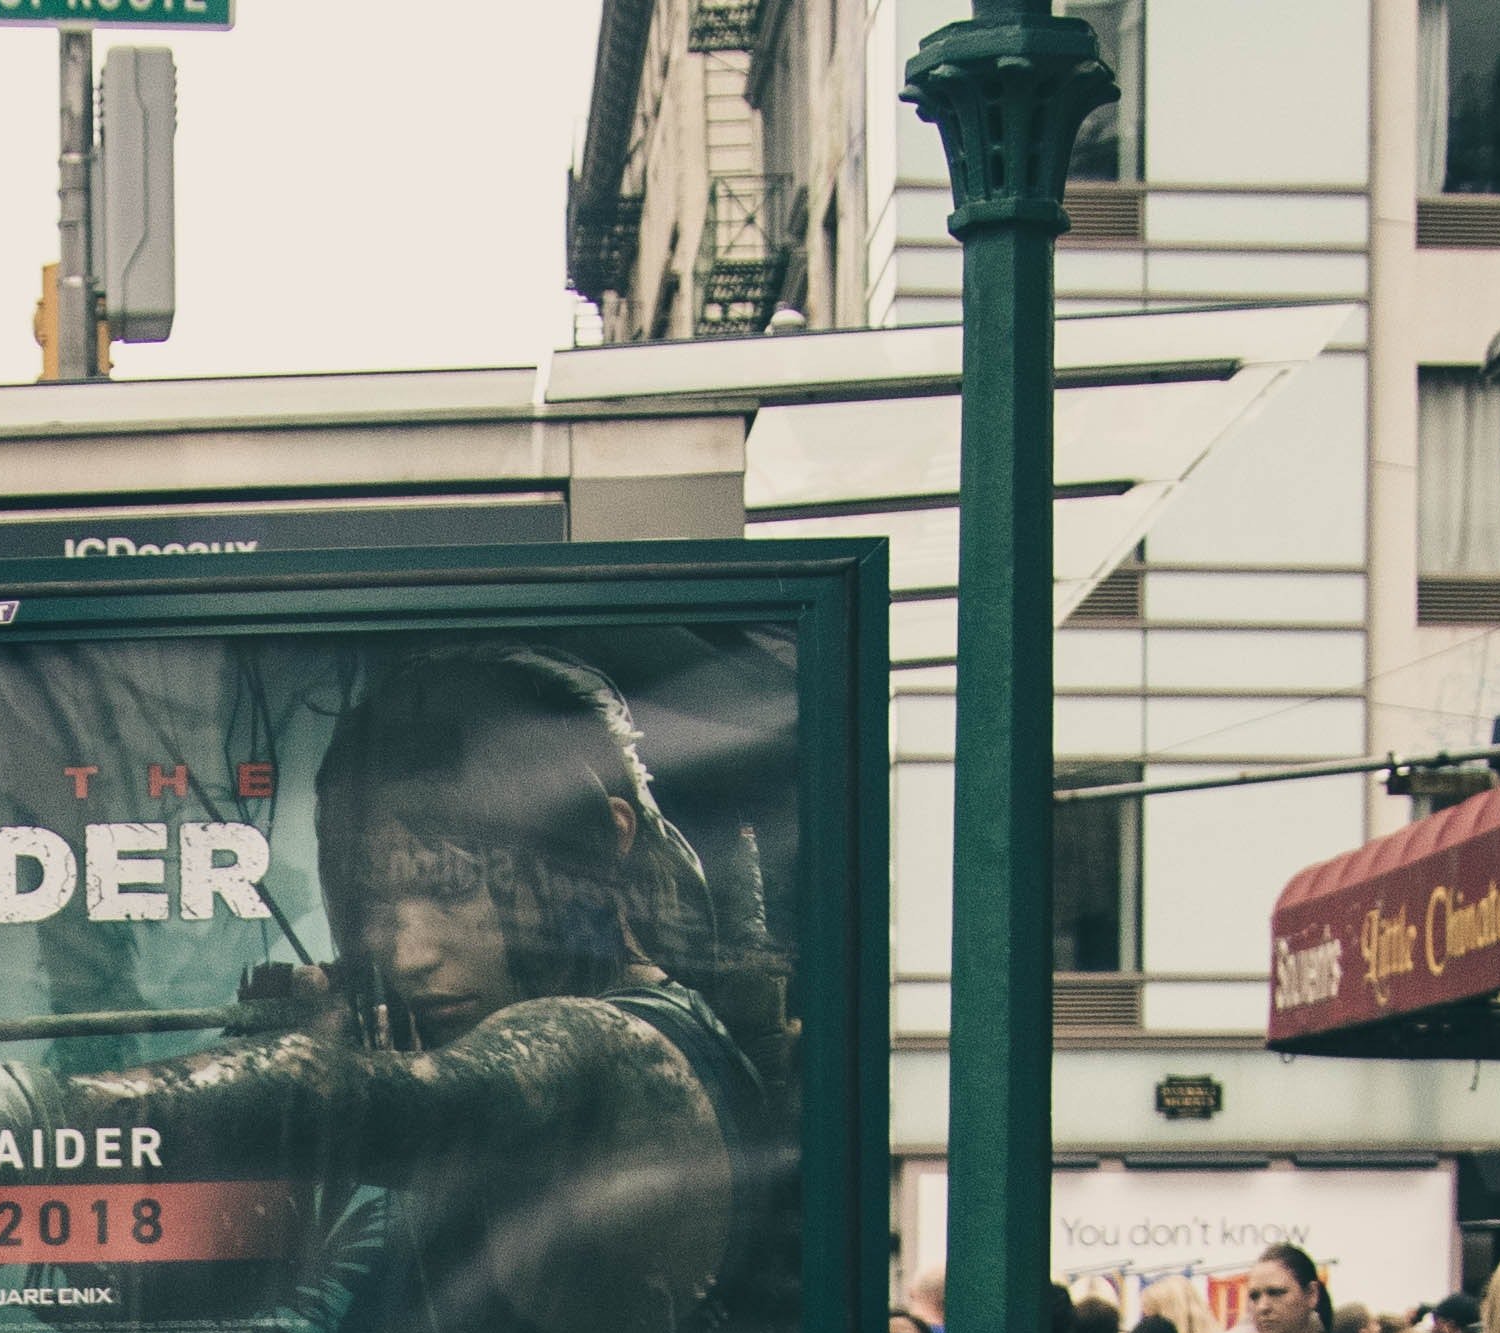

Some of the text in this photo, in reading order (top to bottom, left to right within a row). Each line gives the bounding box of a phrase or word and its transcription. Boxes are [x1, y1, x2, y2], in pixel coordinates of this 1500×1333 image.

[65, 763, 274, 799] THE
[1061, 1216, 1311, 1246] You don't know
[58, 1287, 113, 1304] ENIX
